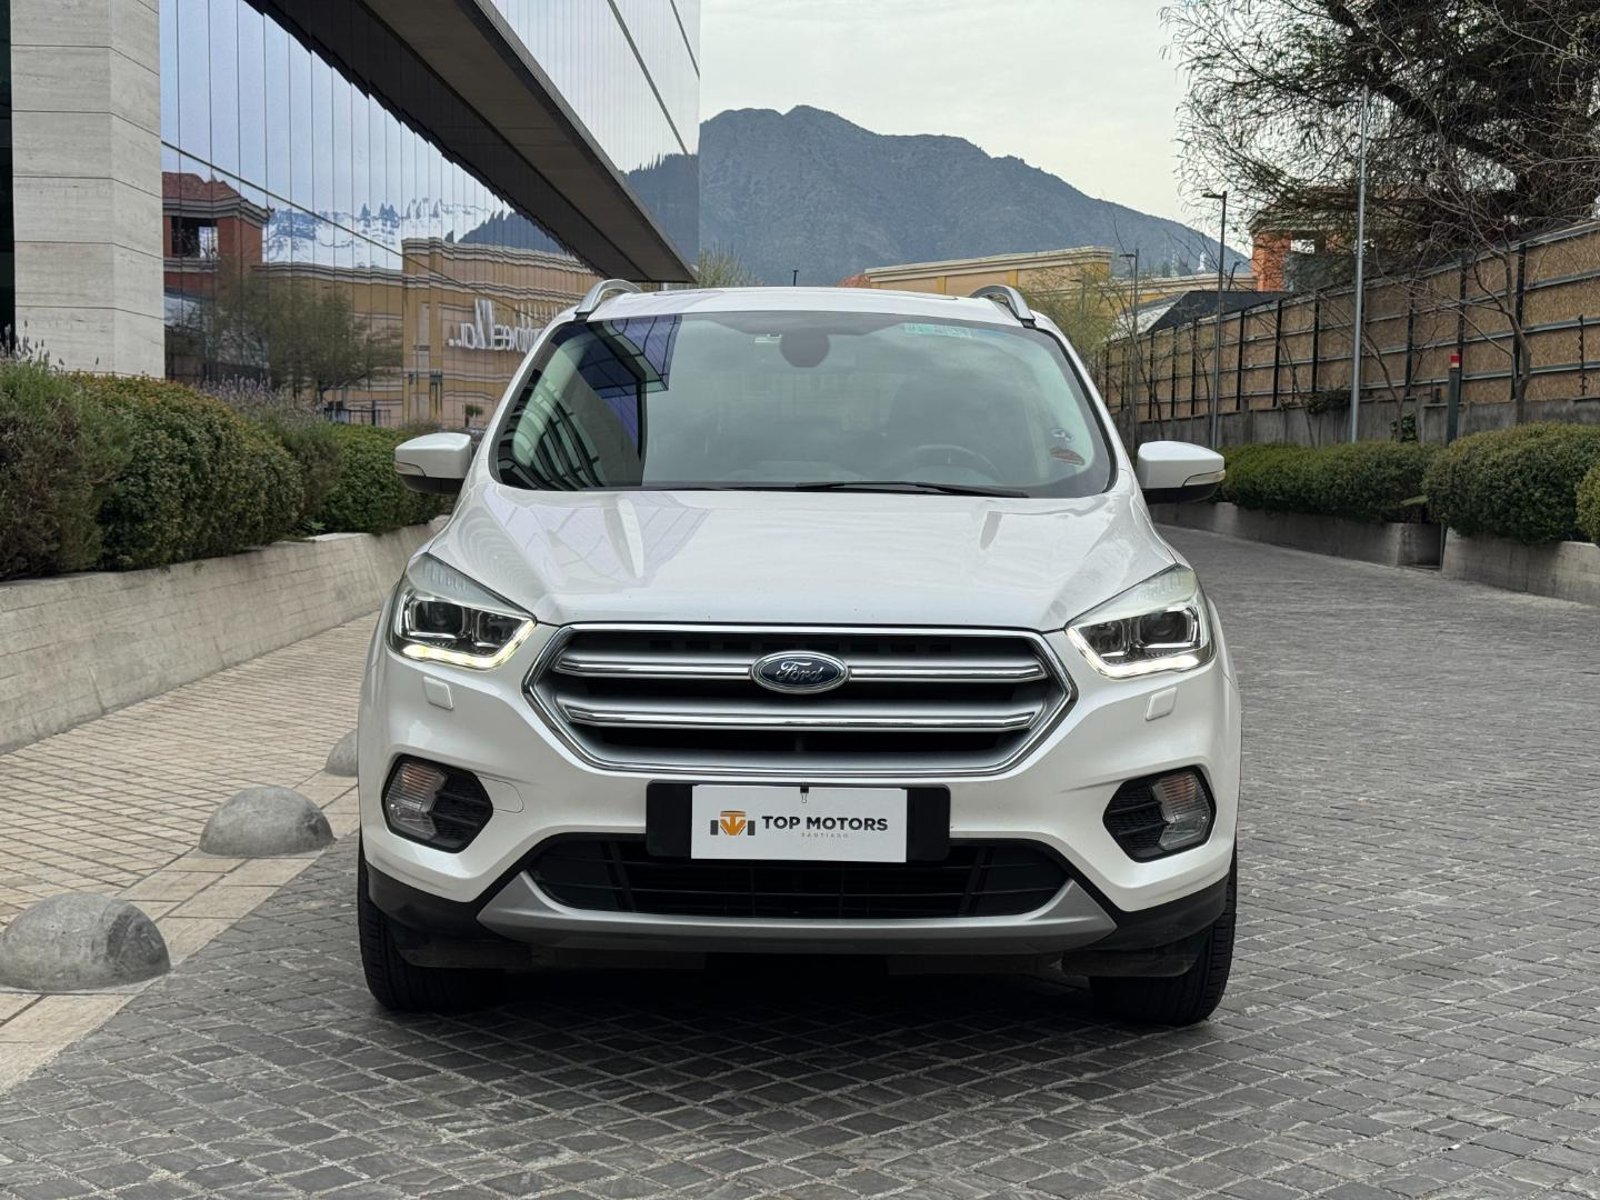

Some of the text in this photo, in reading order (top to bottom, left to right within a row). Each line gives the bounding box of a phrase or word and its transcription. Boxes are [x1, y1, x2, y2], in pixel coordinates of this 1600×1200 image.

[776, 661, 824, 680] Ford
[761, 815, 889, 831] TOP MOTORS
